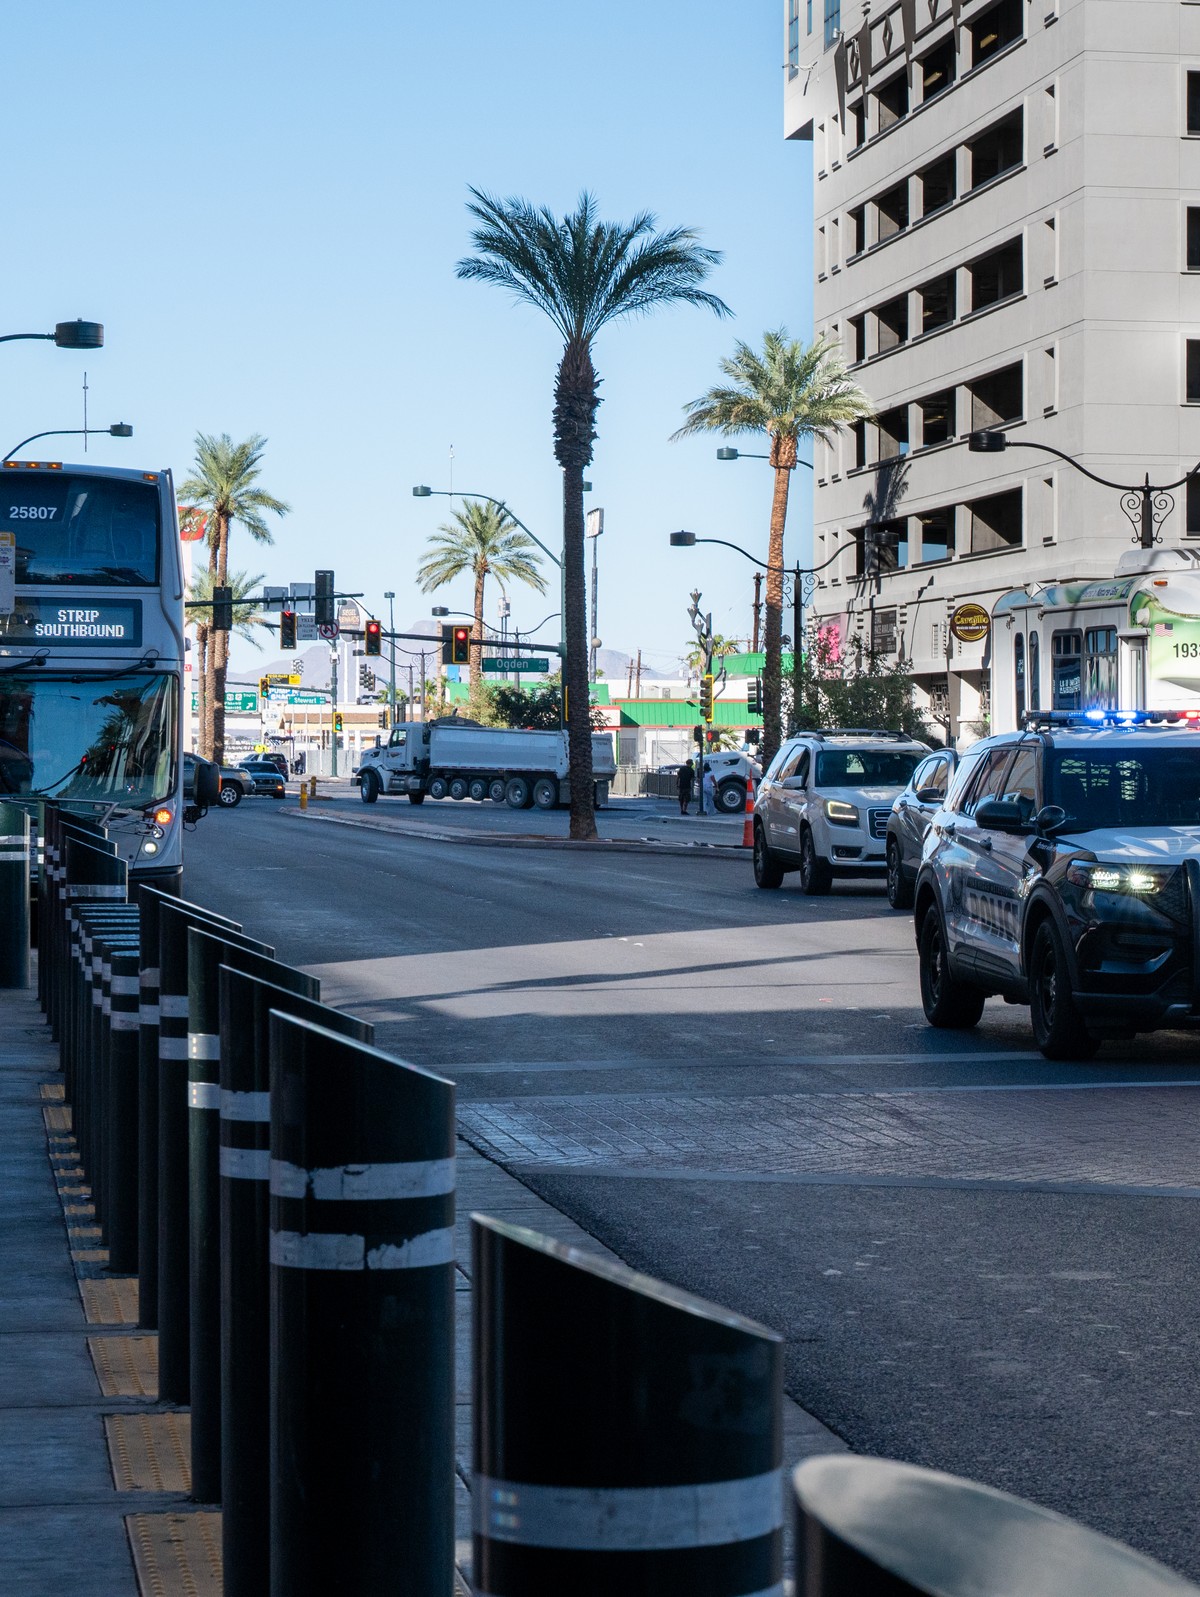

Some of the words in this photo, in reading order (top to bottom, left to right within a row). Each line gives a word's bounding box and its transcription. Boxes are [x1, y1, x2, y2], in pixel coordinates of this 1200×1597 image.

[9, 506, 58, 519] 25807
[57, 609, 100, 623] STRIP
[35, 623, 125, 637] SOUTHBOUND
[496, 658, 529, 671] Ogden
[293, 696, 317, 704] Stewart
